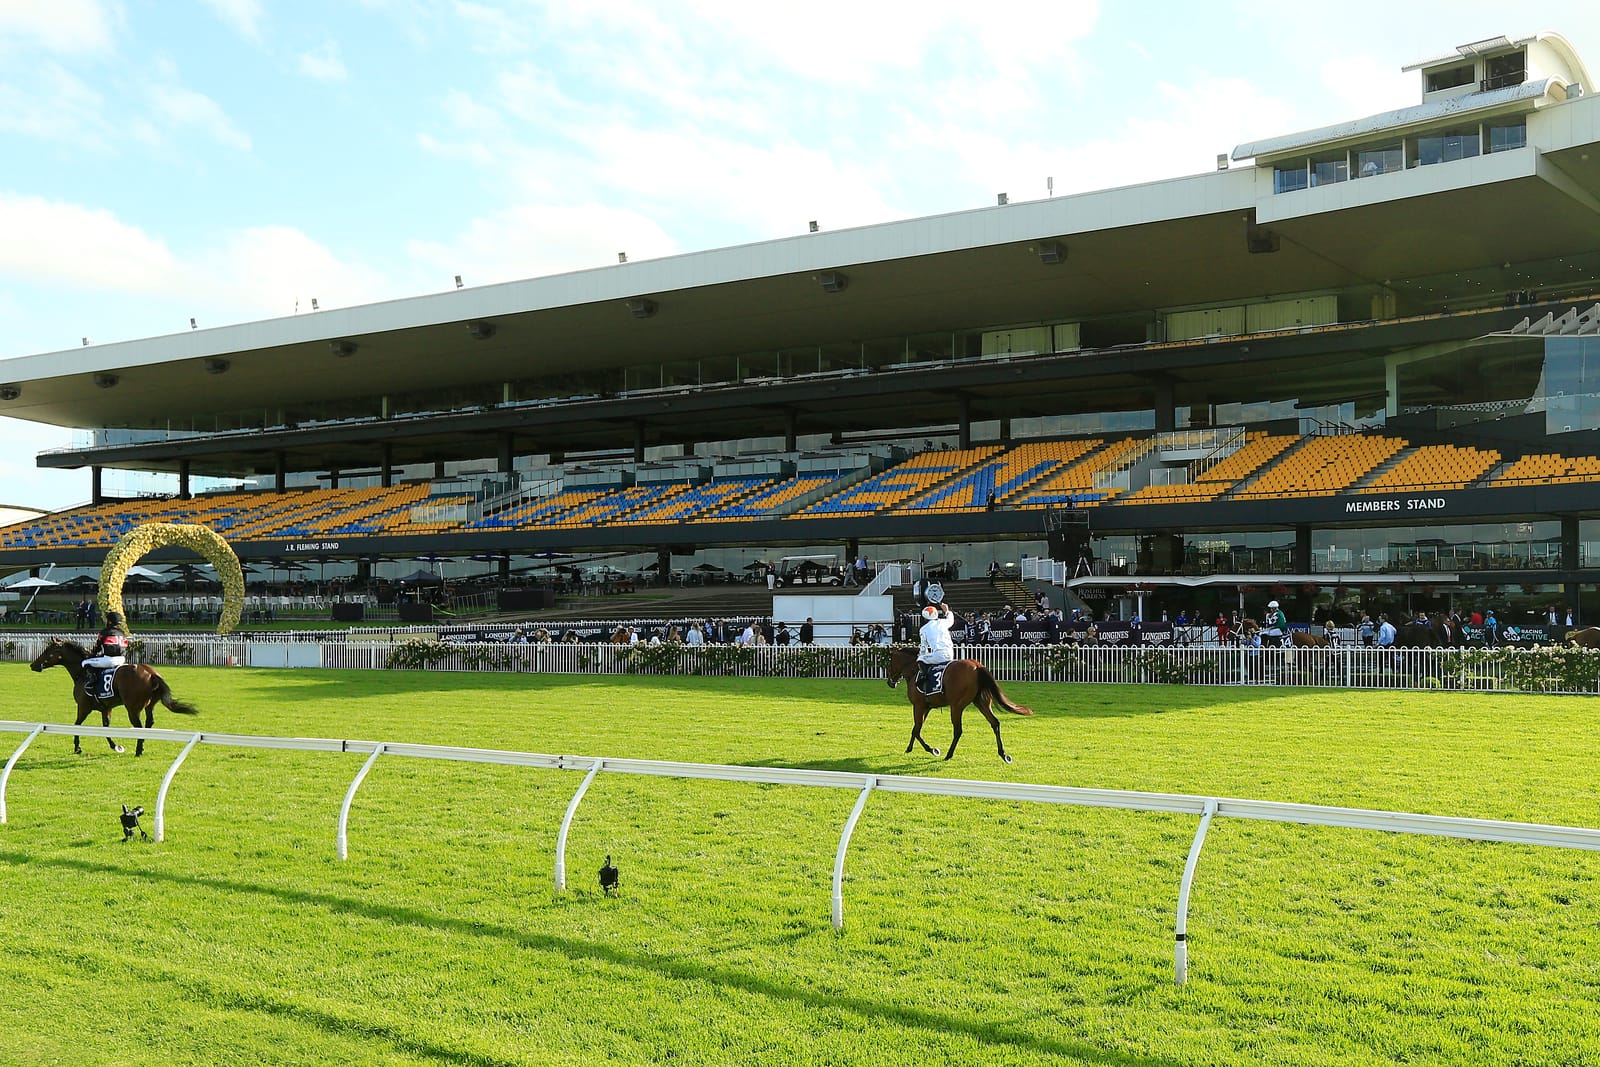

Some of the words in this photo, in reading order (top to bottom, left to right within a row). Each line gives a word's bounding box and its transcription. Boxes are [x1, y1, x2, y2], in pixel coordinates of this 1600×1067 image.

[1346, 500, 1400, 512] MEMBERS
[1407, 498, 1446, 510] STAND
[297, 543, 319, 551] FLEMING
[322, 542, 339, 550] STAND
[1098, 631, 1129, 640] LONGINES
[1141, 632, 1171, 641] LONGINES
[104, 674, 113, 692] 8
[934, 671, 942, 688] 3
